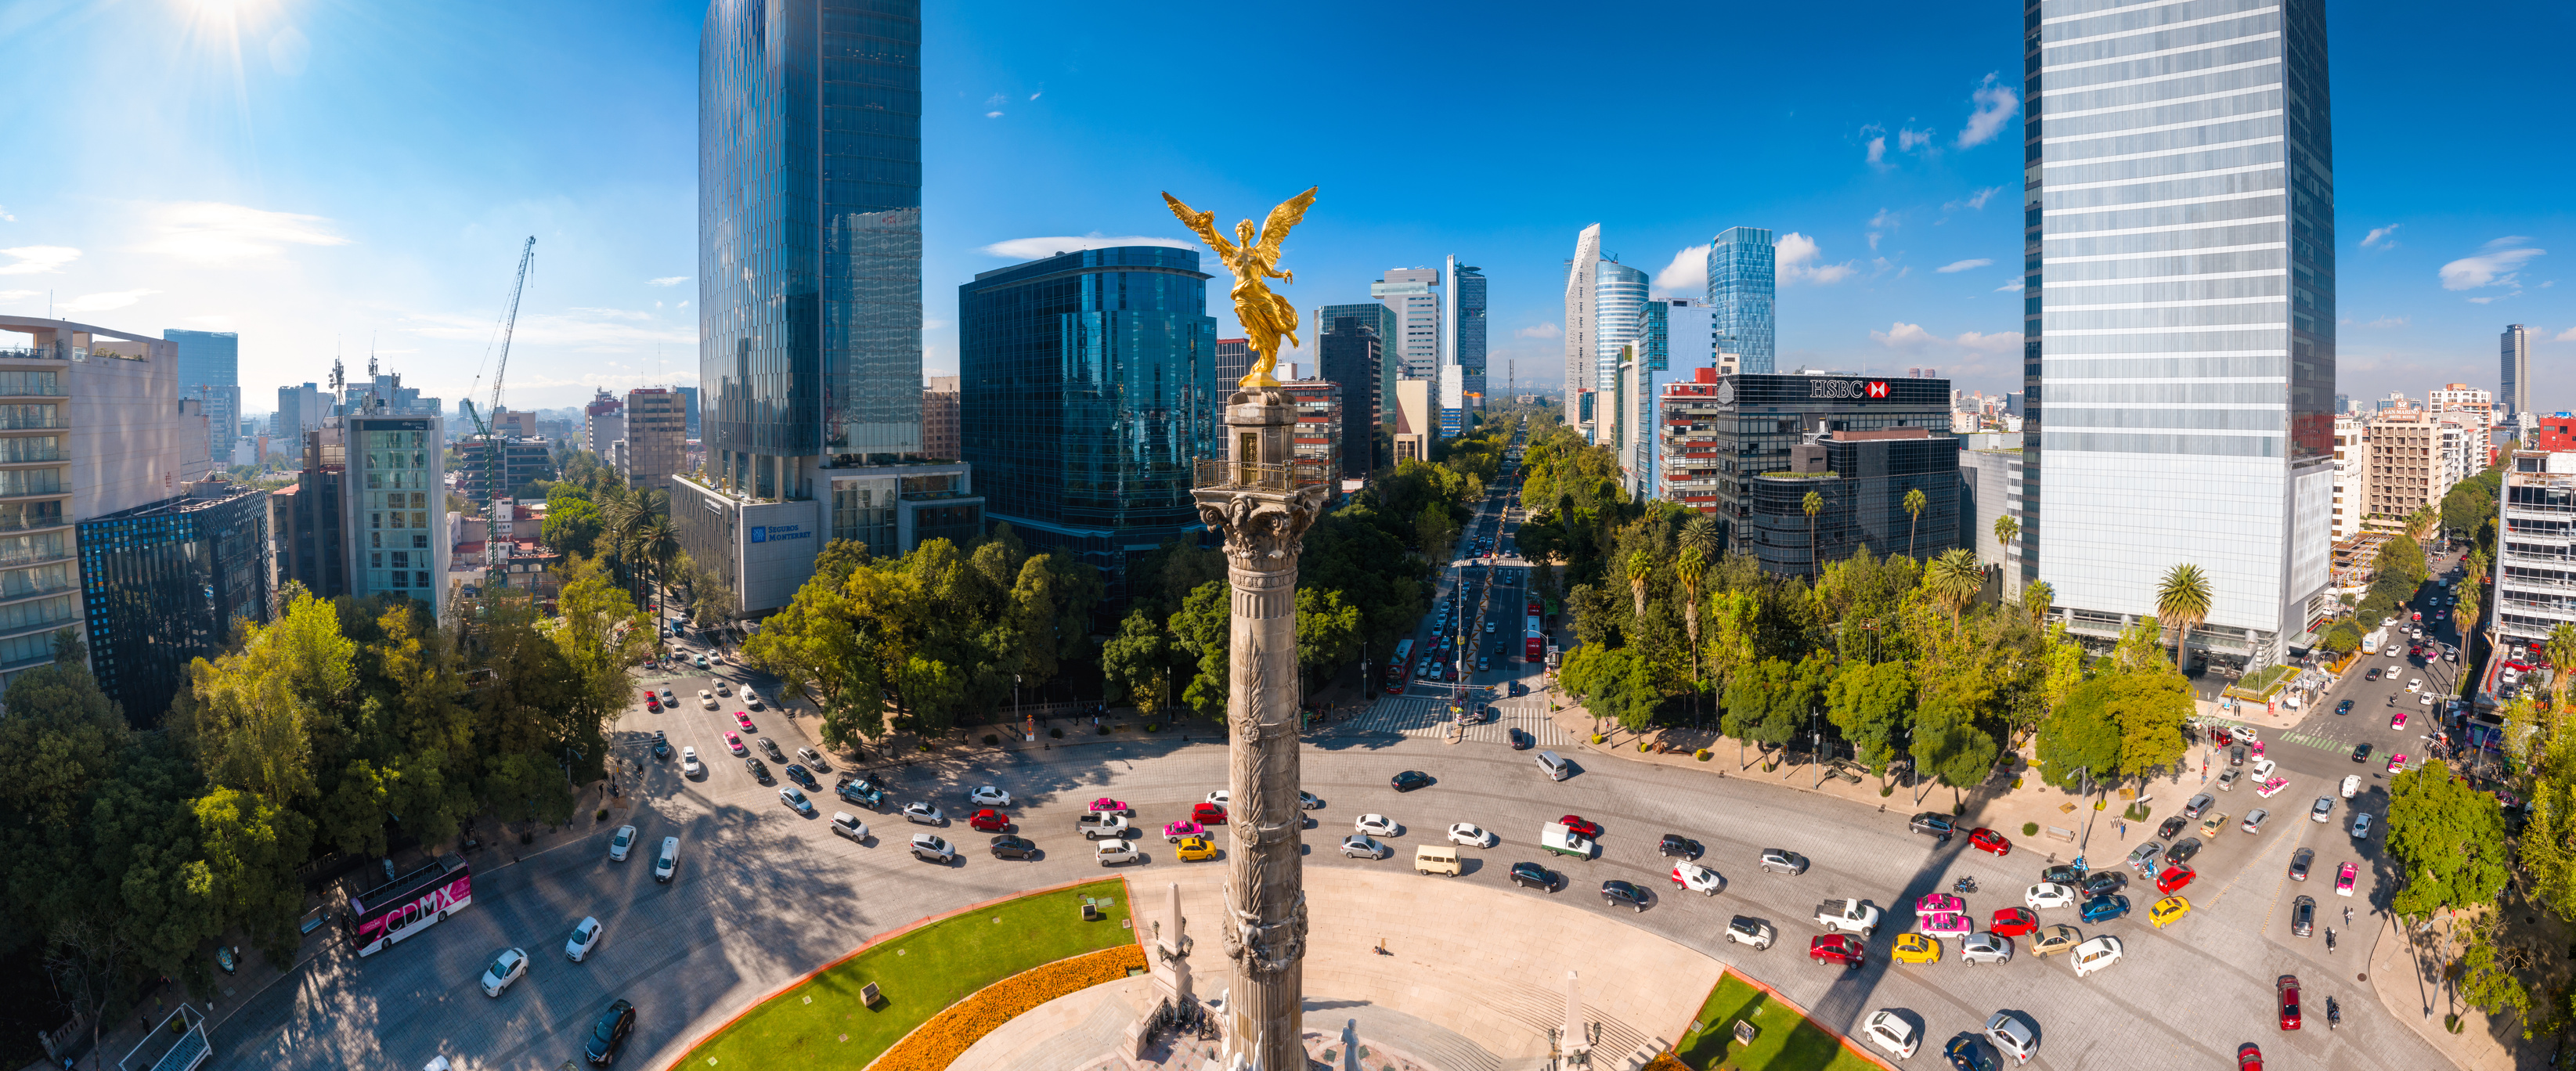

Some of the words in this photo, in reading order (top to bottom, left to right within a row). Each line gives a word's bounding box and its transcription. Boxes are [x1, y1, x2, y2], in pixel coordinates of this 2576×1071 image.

[1809, 379, 1863, 398] HSBC
[768, 525, 799, 533] SEGUROS
[768, 531, 812, 542] MONTERREY
[386, 882, 456, 932] CDMX
